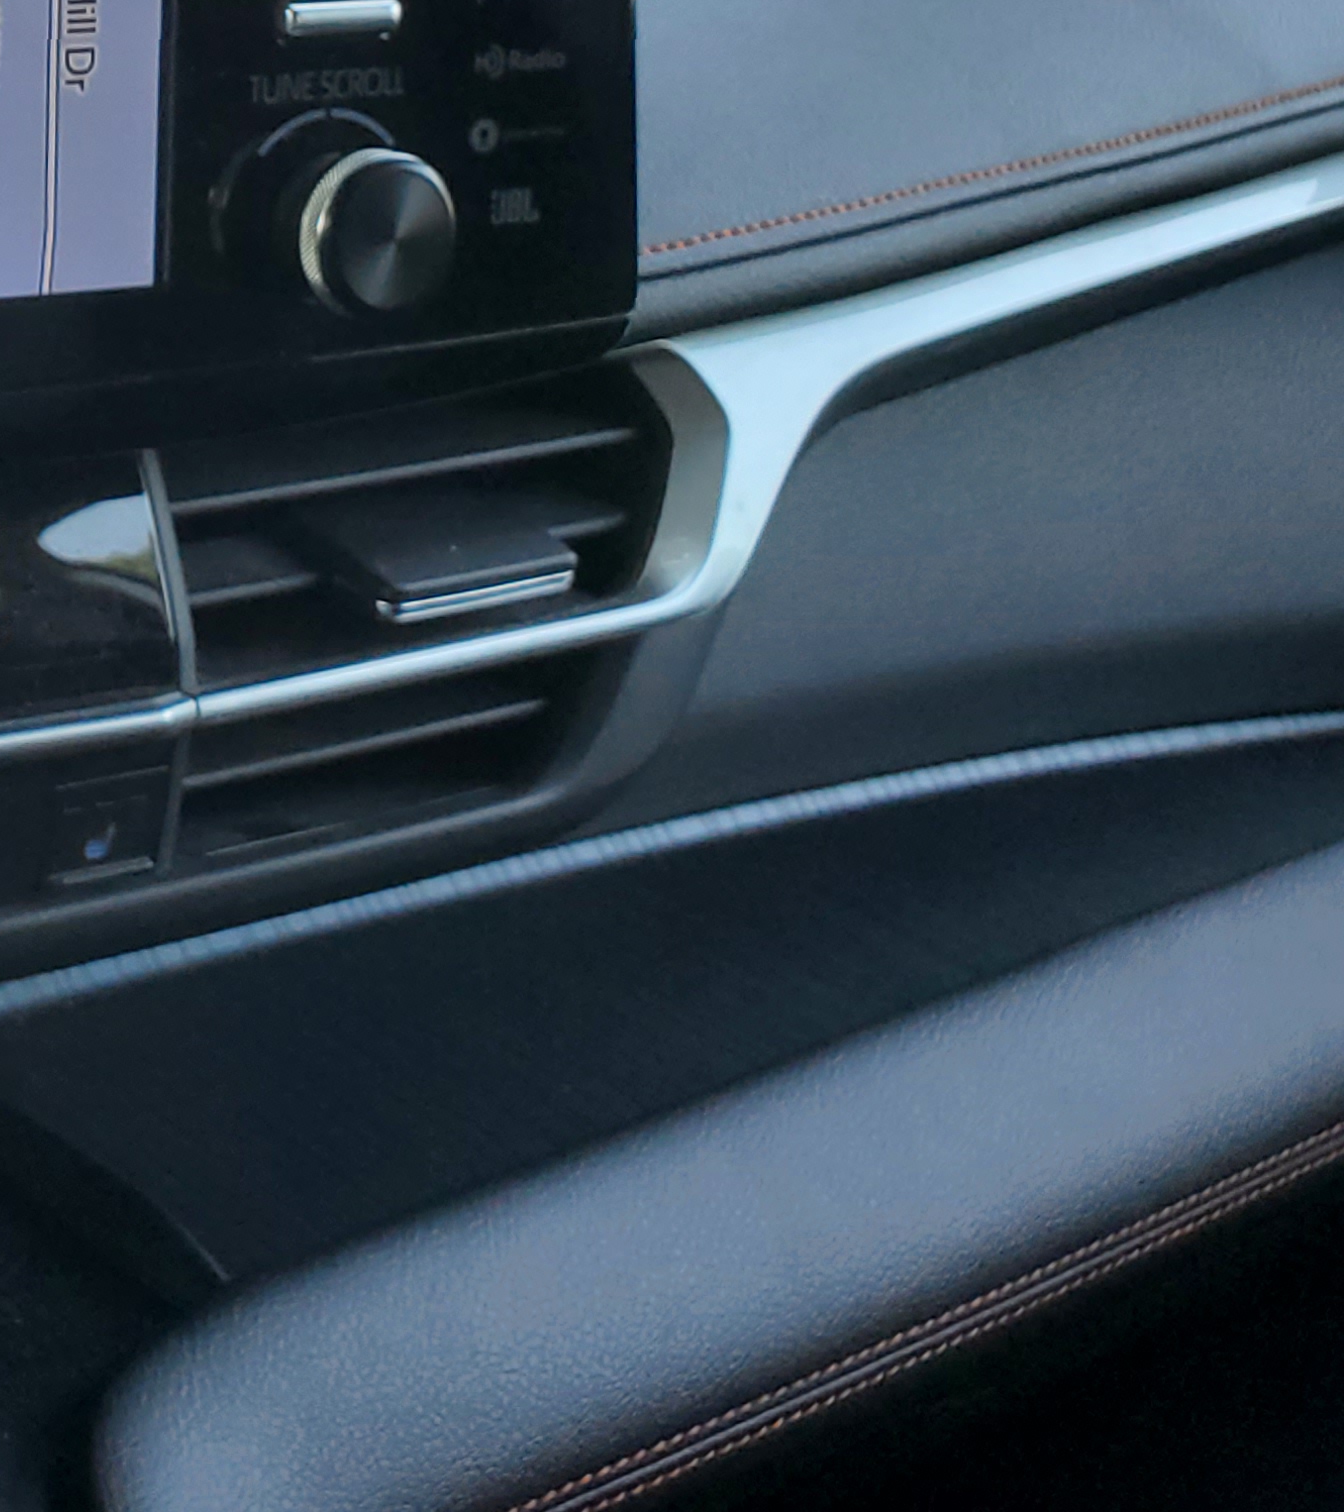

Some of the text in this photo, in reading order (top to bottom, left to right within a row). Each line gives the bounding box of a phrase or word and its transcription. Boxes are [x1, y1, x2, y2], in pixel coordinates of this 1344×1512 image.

[64, 46, 96, 92] Dr
[249, 67, 404, 105] TUNE SCROLL
